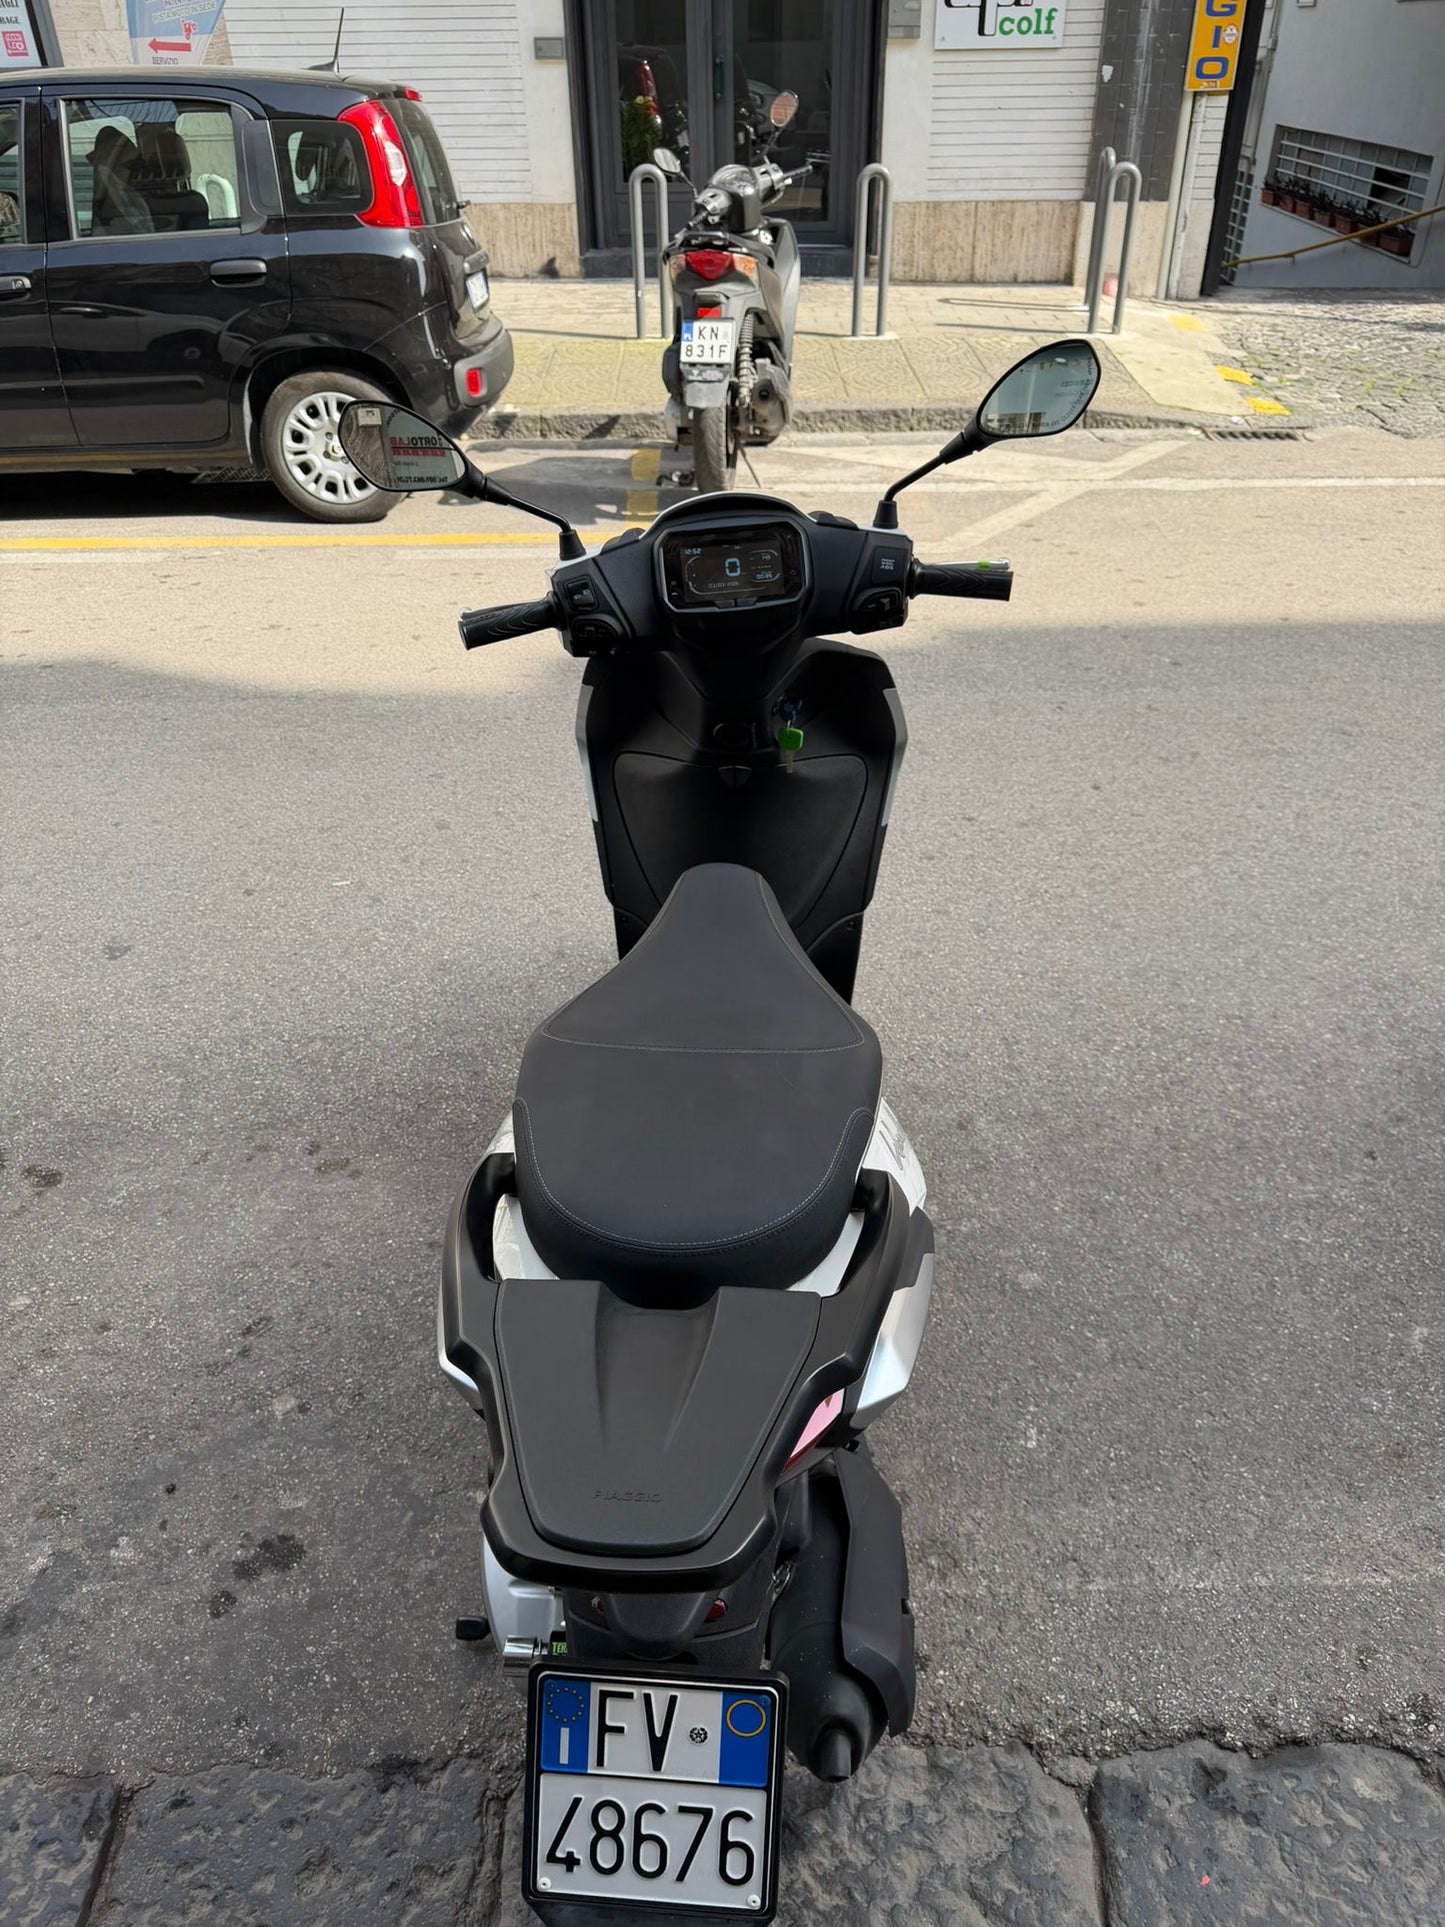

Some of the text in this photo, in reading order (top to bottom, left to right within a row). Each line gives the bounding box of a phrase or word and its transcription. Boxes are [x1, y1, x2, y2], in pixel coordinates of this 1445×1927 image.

[999, 7, 1058, 36] colf
[697, 326, 719, 341] KN
[685, 344, 727, 359] 831F
[725, 557, 741, 577] 0
[592, 1489, 663, 1503] PIAGGIO
[597, 1689, 679, 1772] FV
[546, 1796, 755, 1886] 48676
